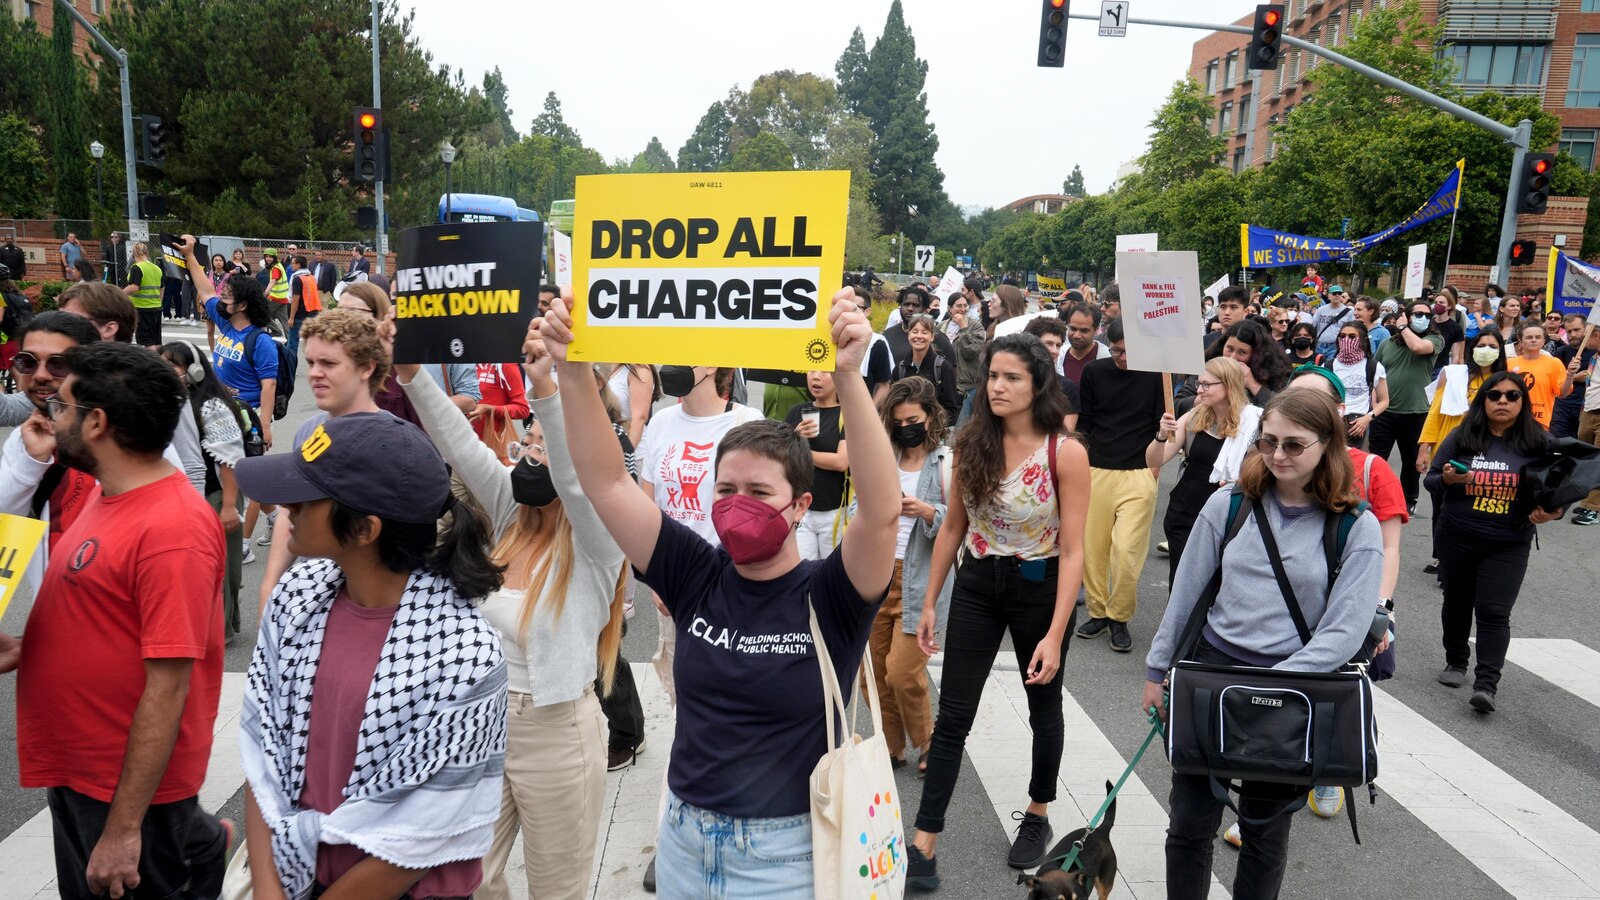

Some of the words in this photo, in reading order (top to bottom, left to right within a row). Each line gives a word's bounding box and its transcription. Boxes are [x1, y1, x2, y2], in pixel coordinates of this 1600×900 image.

[590, 218, 718, 260] DROP
[723, 216, 822, 258] ALL
[1274, 235, 1309, 250] UCLA
[1253, 249, 1273, 265] WE
[1277, 248, 1321, 263] STAND
[397, 268, 423, 292] WE
[423, 262, 496, 289] WON'T
[588, 278, 817, 321] CHARGES
[1145, 291, 1174, 299] WORKERS
[396, 294, 448, 319] BACK
[448, 290, 520, 316] DOWN
[1143, 305, 1179, 319] PALESTINE
[682, 463, 704, 472] FREE
[1471, 459, 1509, 471] Speaks:
[1465, 484, 1518, 502] NOTHIN
[1472, 497, 1510, 515] LESS!
[687, 613, 730, 650] CLA
[739, 635, 780, 645] FIELDING
[782, 633, 814, 644] SCHOO
[736, 645, 770, 654] PUBLIC
[771, 645, 807, 654] HEALTH
